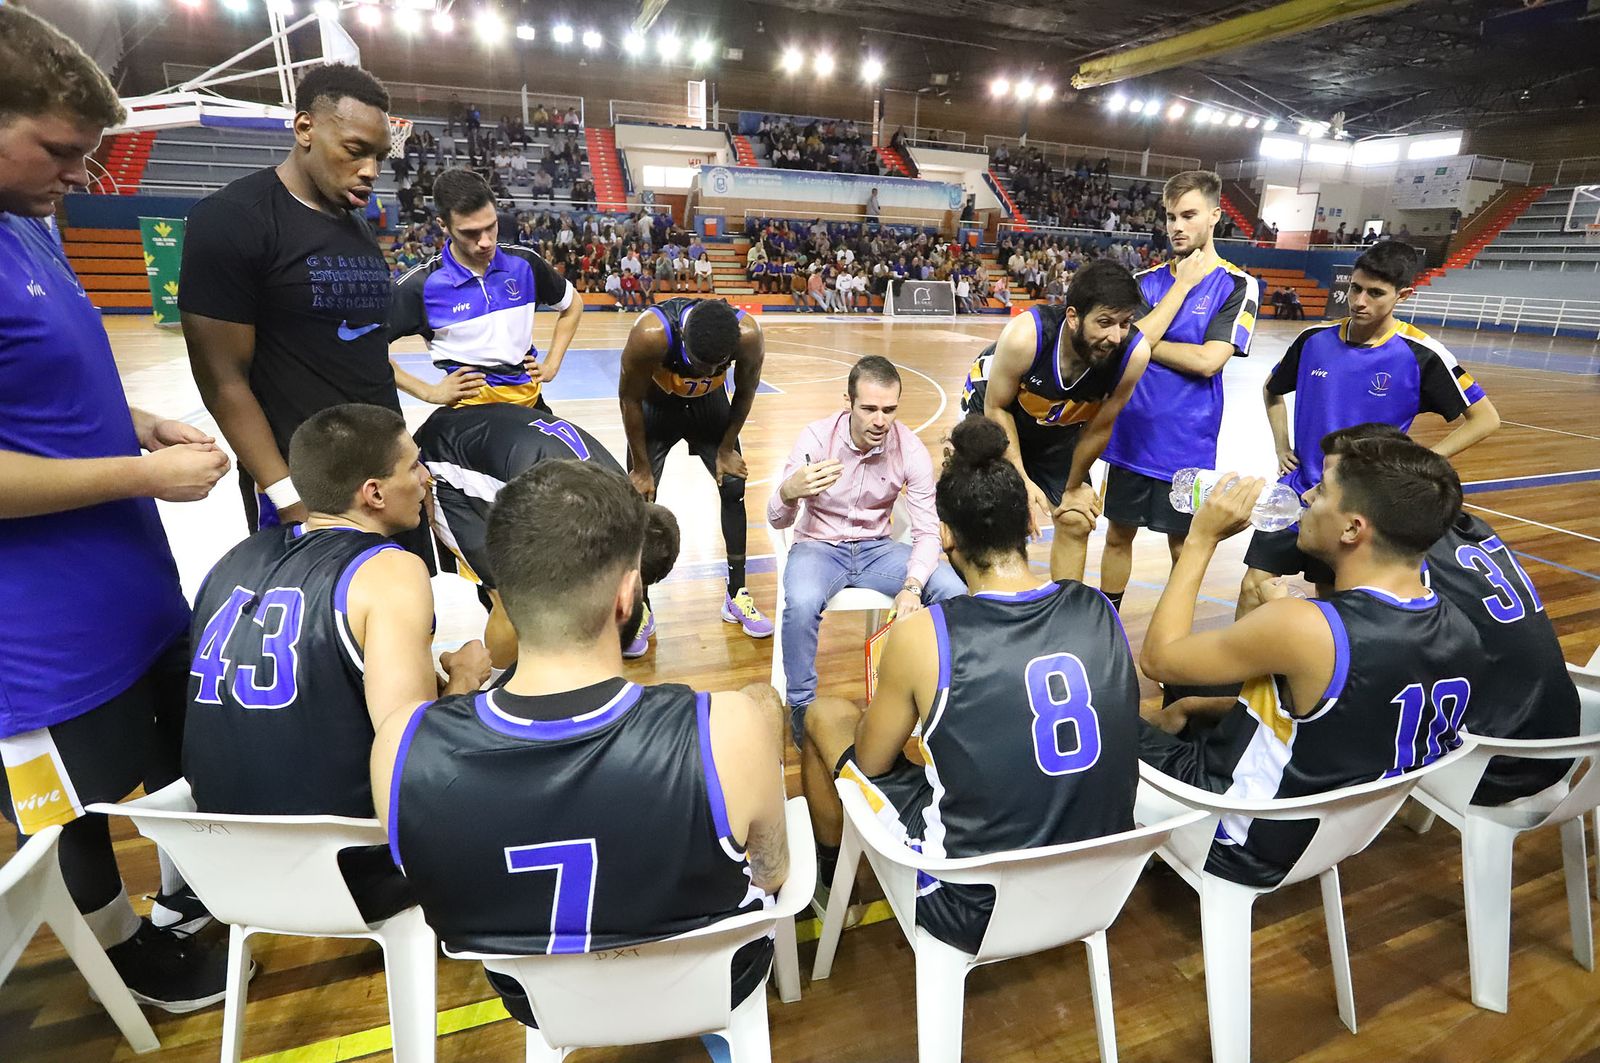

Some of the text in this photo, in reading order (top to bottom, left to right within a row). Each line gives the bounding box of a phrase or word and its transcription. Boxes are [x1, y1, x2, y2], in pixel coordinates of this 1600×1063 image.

[683, 379, 713, 397] 77
[528, 418, 591, 462] 4
[1455, 535, 1544, 624] 37
[189, 585, 305, 709] 43
[1024, 652, 1102, 776] 8
[1377, 677, 1471, 779] 10
[504, 838, 599, 955] 7
